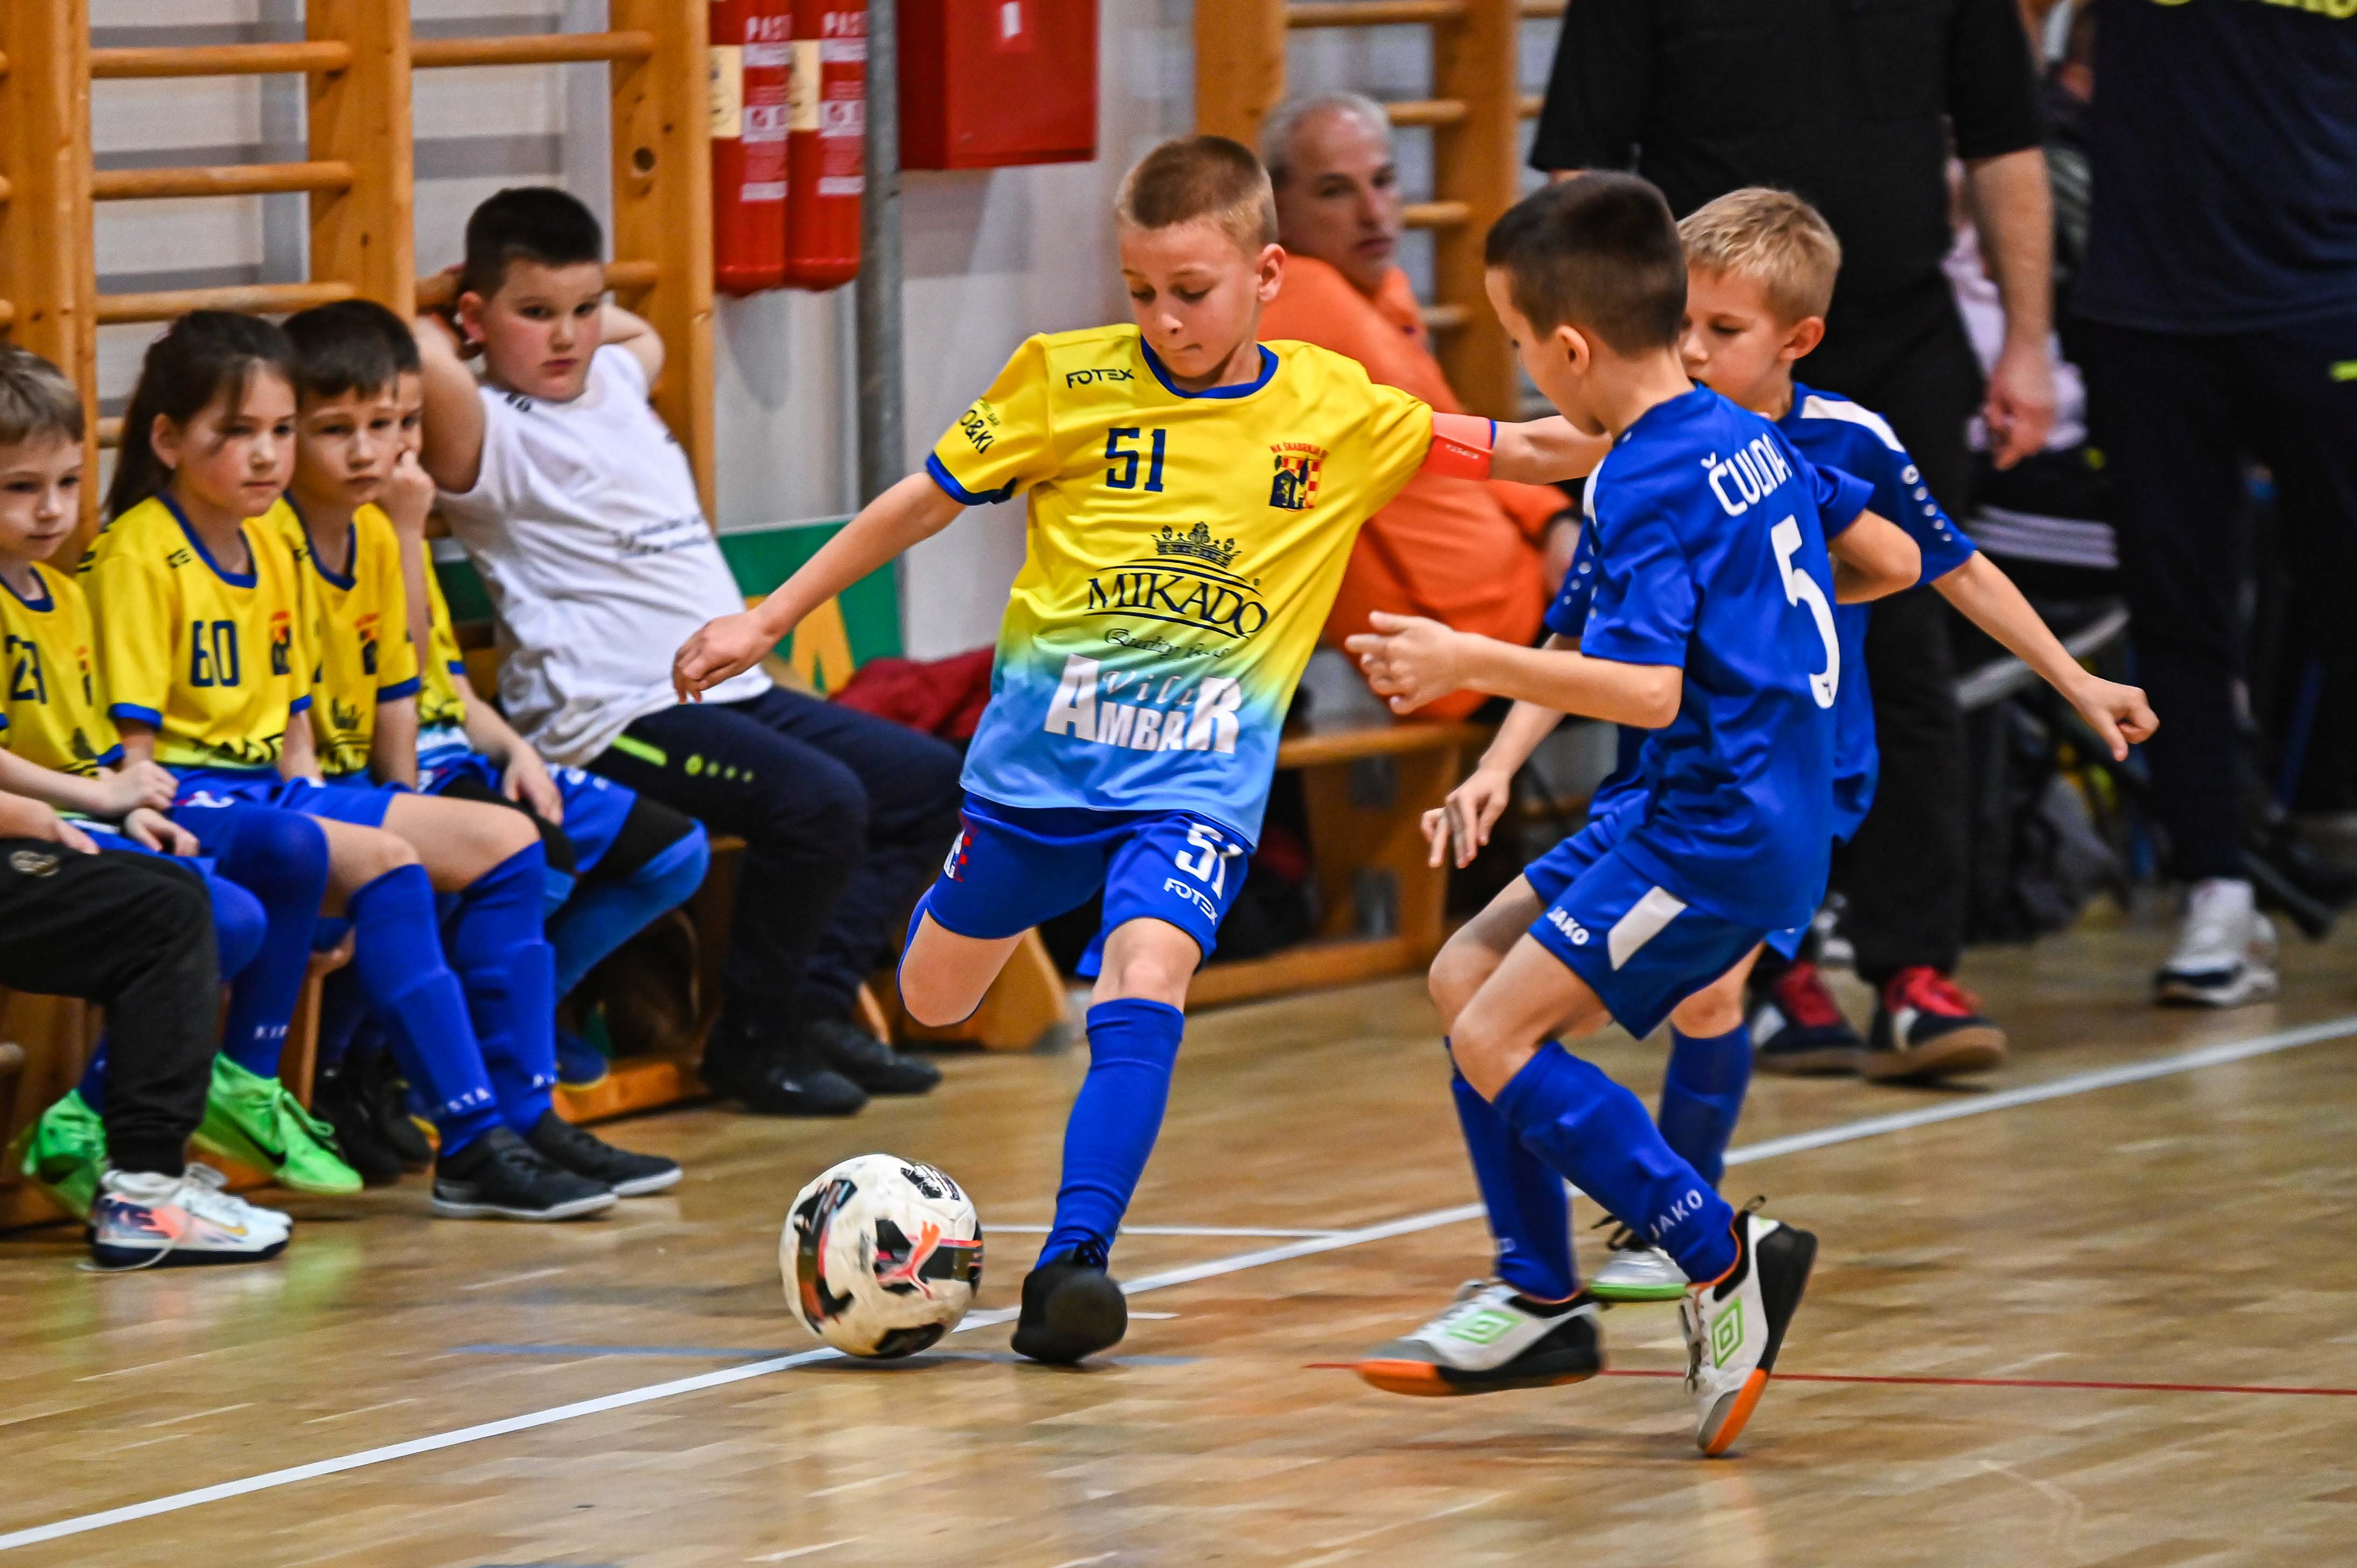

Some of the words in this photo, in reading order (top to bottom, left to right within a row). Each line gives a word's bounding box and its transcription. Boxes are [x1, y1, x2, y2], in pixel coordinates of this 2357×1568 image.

[1066, 369, 1135, 389] FOTEX
[1105, 427, 1166, 492] 51
[1087, 572, 1269, 639] MIKADO
[1770, 514, 1840, 709] 5
[191, 620, 240, 687] 60
[1044, 653, 1242, 754] AMBAR
[1175, 822, 1243, 900] 51
[1546, 906, 1589, 946] JAKO
[1650, 1188, 1703, 1239] JAKO
